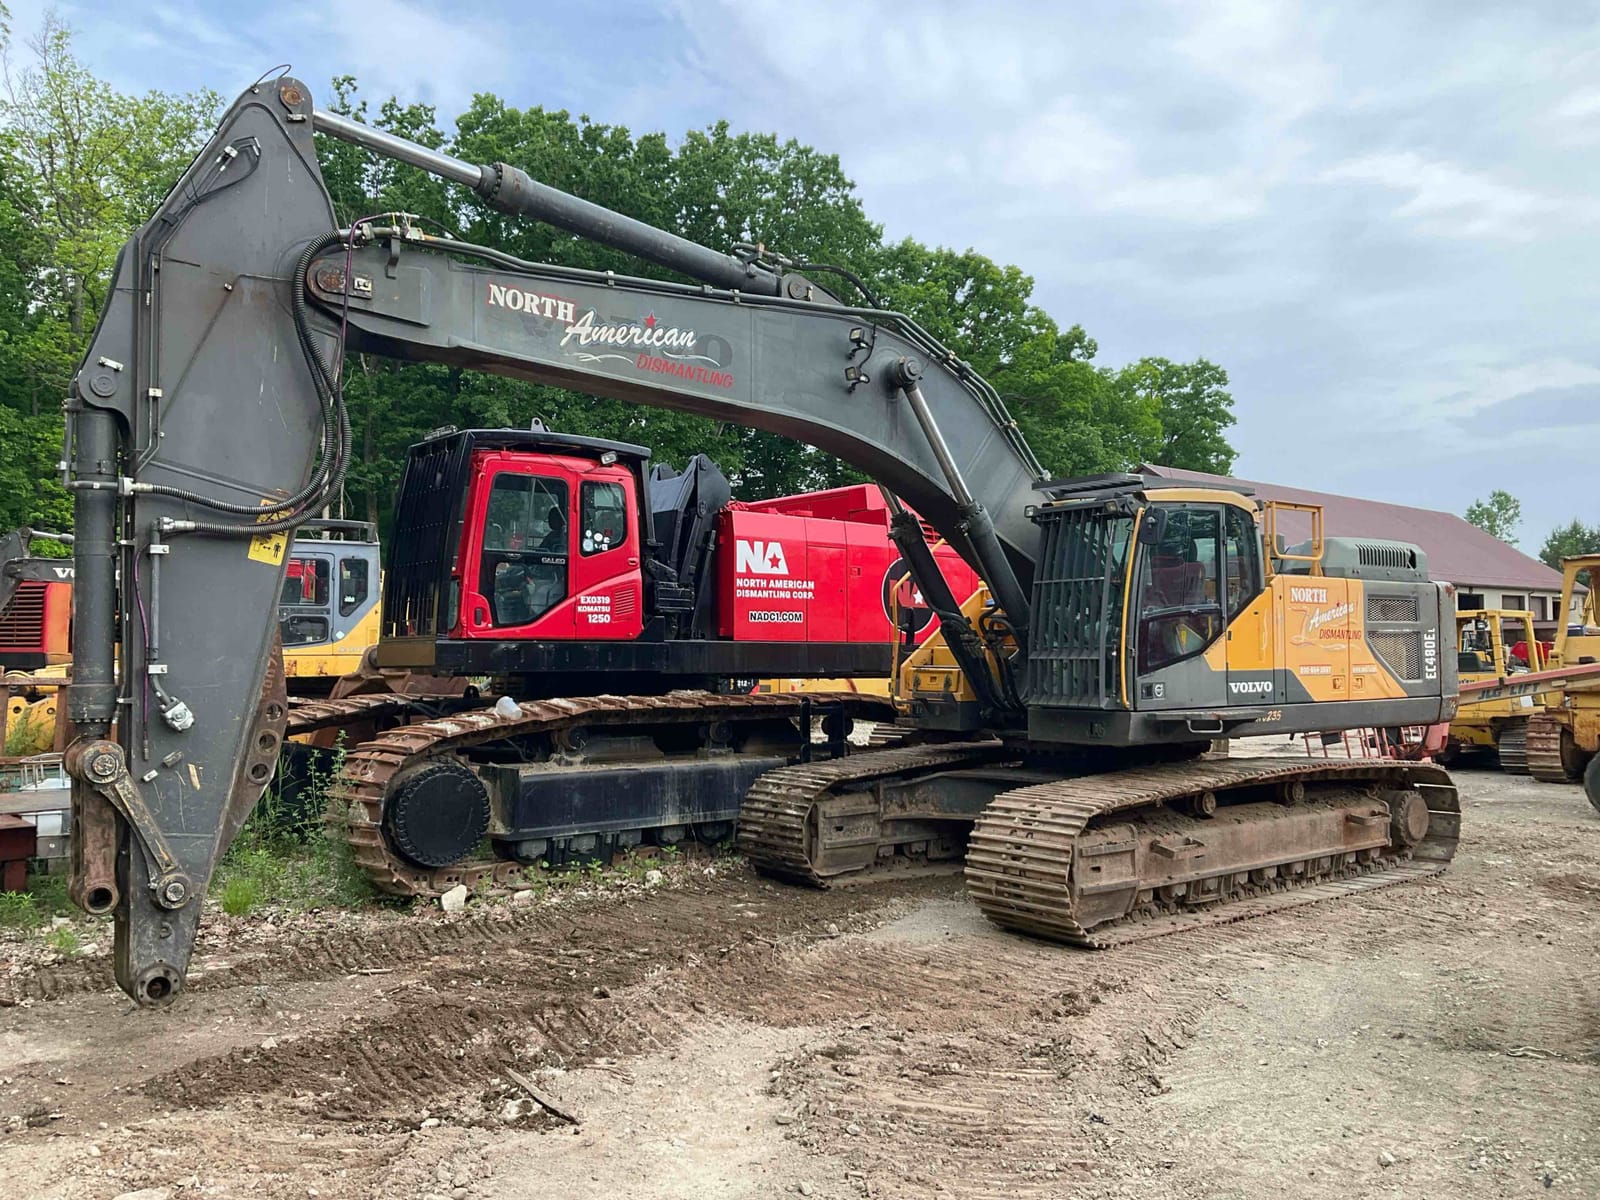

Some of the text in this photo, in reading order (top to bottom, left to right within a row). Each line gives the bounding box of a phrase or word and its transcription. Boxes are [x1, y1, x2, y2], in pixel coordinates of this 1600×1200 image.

[488, 284, 575, 323] NORTH
[559, 310, 697, 347] American
[636, 353, 734, 388] DISMANTLING
[736, 578, 815, 589] NORTH AMERICAN
[736, 589, 815, 600] DISMANTLING CORP.
[1290, 587, 1328, 603] NORTH
[577, 605, 611, 613] KOMATSU
[1308, 601, 1355, 631] American
[587, 614, 611, 623] 1250
[749, 611, 803, 623] NADC1.COM
[1318, 627, 1362, 640] DISMANTLING
[1228, 680, 1273, 694] VOLVO
[1478, 682, 1541, 700] JLG LIFT
